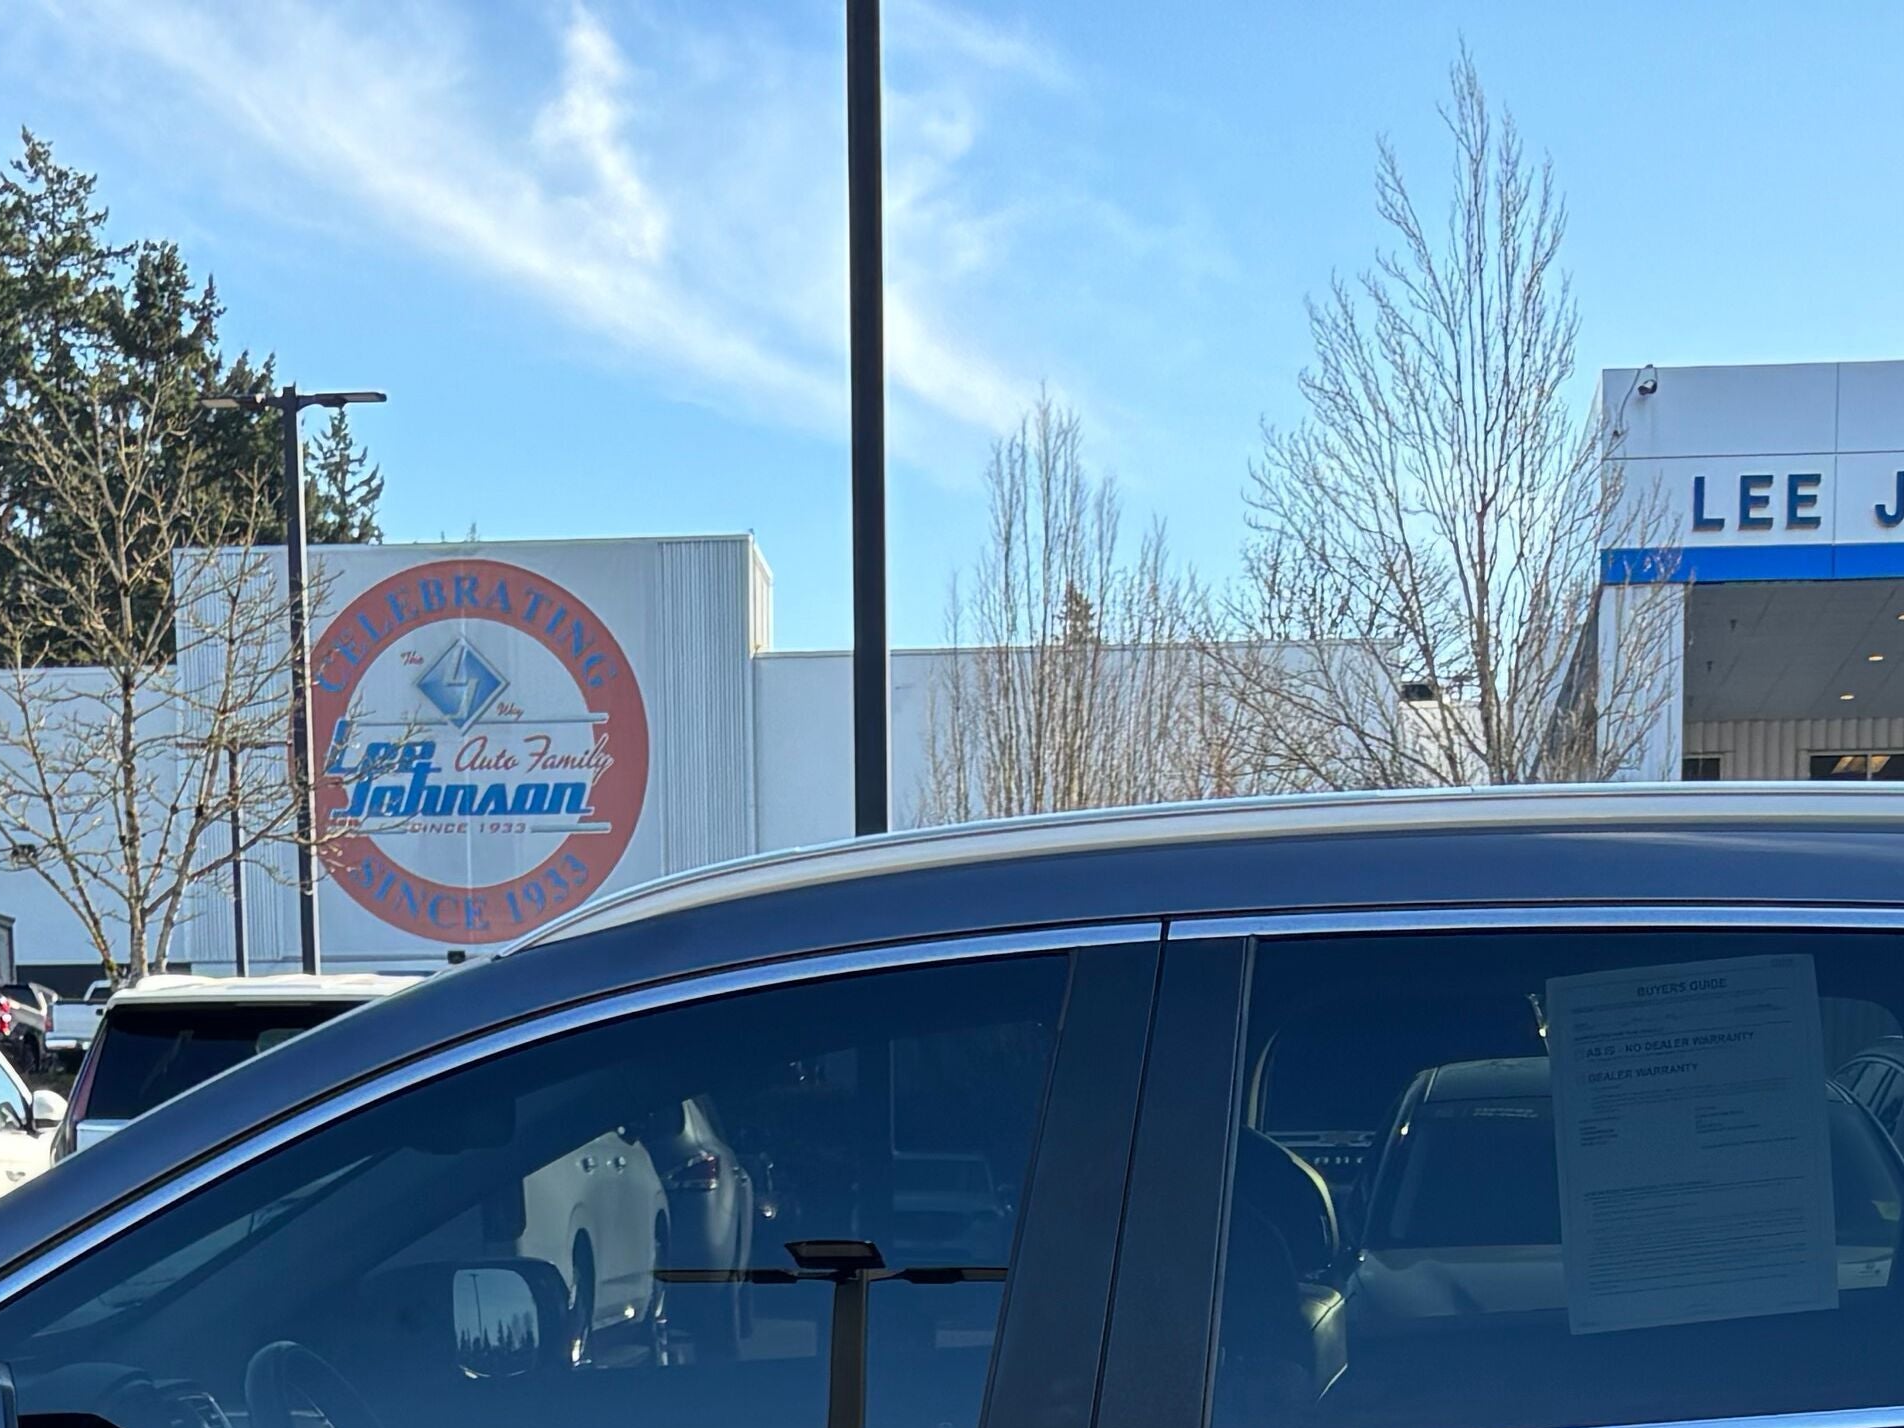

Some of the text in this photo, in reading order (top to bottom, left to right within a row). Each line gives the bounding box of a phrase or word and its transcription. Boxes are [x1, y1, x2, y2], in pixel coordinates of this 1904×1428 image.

[1694, 472, 1822, 532] LEE
[315, 573, 618, 695] CELEBRATING
[325, 719, 615, 783] Lee Auto Family
[330, 762, 594, 818] Johnson
[408, 822, 527, 834] SINCE 1933
[349, 853, 589, 931] SINCE 1933
[1637, 977, 1728, 998] BUYERS GUIDE
[1645, 1037, 1689, 1051] DEALER
[1692, 1031, 1754, 1047] WARRANTY
[1588, 1063, 1698, 1083] DEALER WARRANTY
